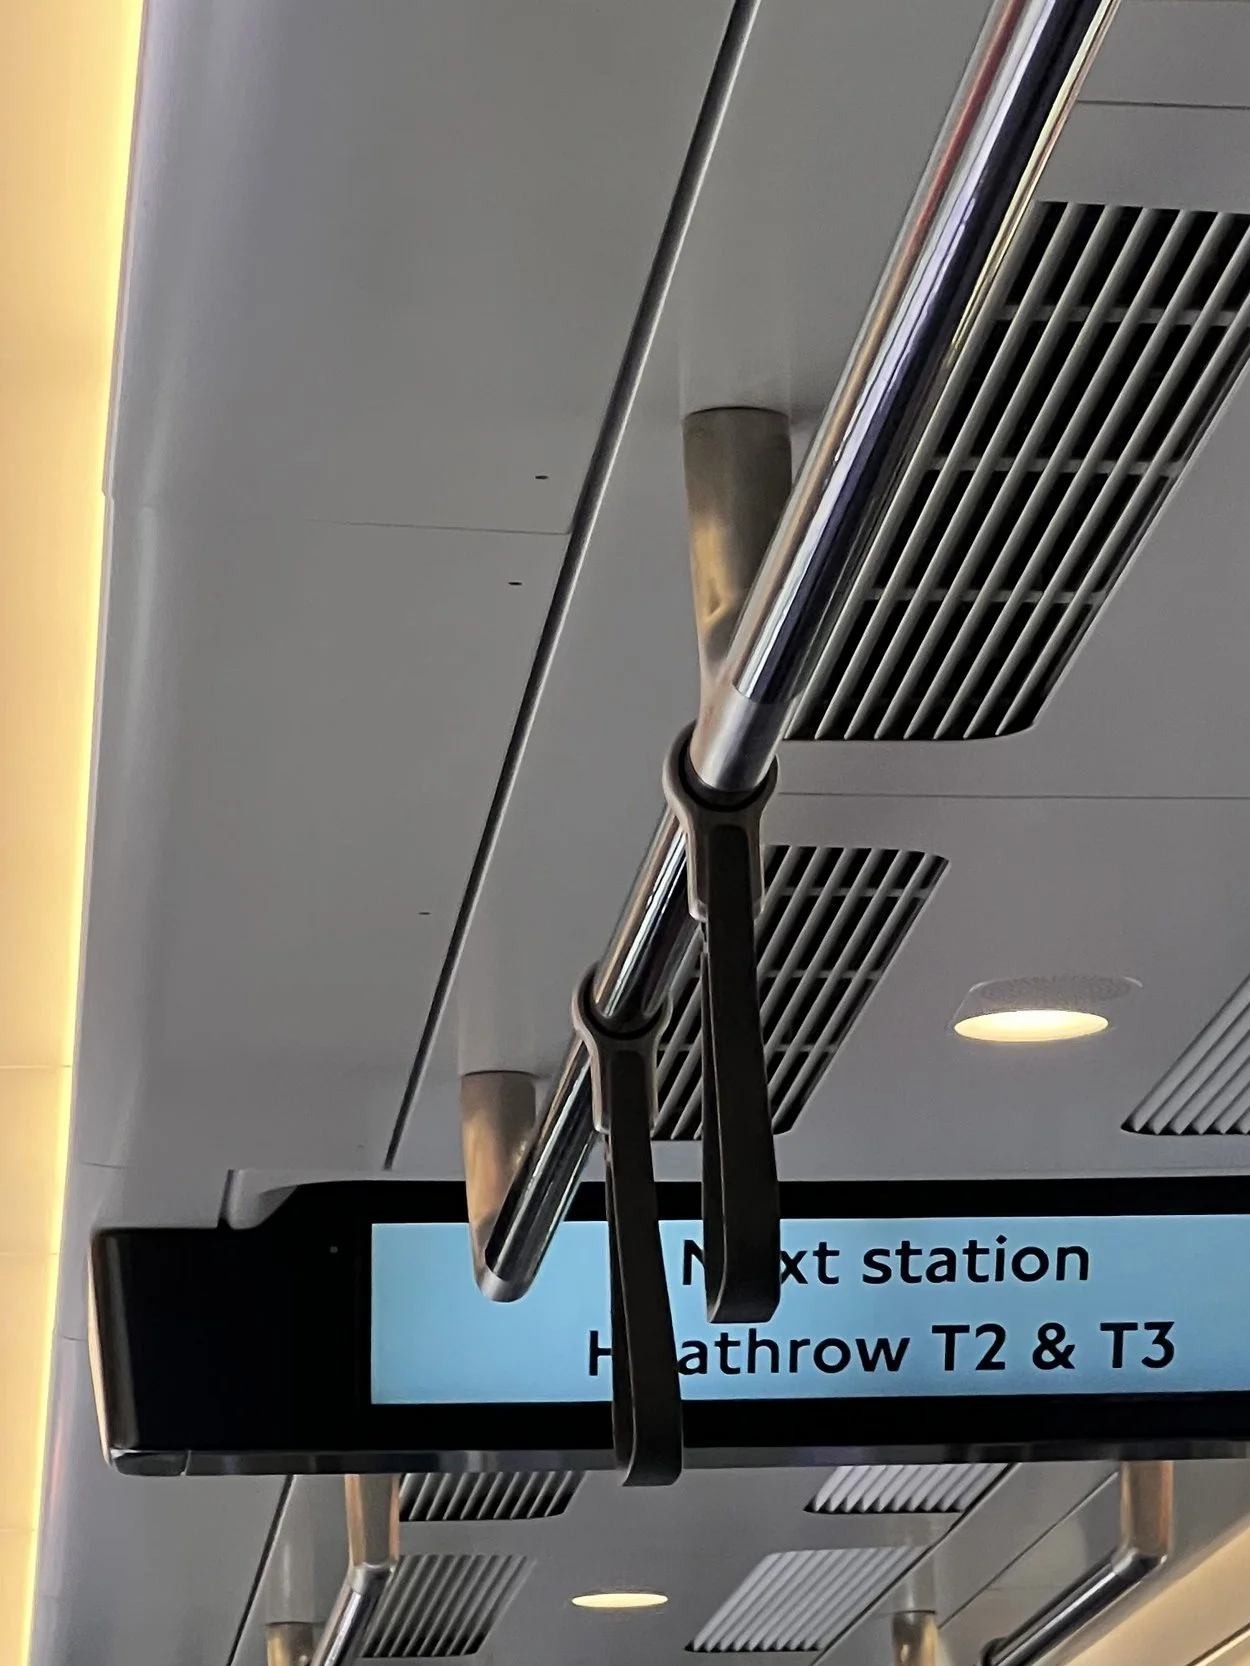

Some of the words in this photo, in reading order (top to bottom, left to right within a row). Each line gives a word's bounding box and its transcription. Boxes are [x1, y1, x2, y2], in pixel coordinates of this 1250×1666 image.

[682, 1239, 839, 1285] Nxt
[862, 1234, 1089, 1284] station
[588, 1328, 910, 1376] Hathrow
[932, 1323, 1006, 1371] T2
[1032, 1322, 1075, 1370] &
[1100, 1321, 1175, 1369] T3
